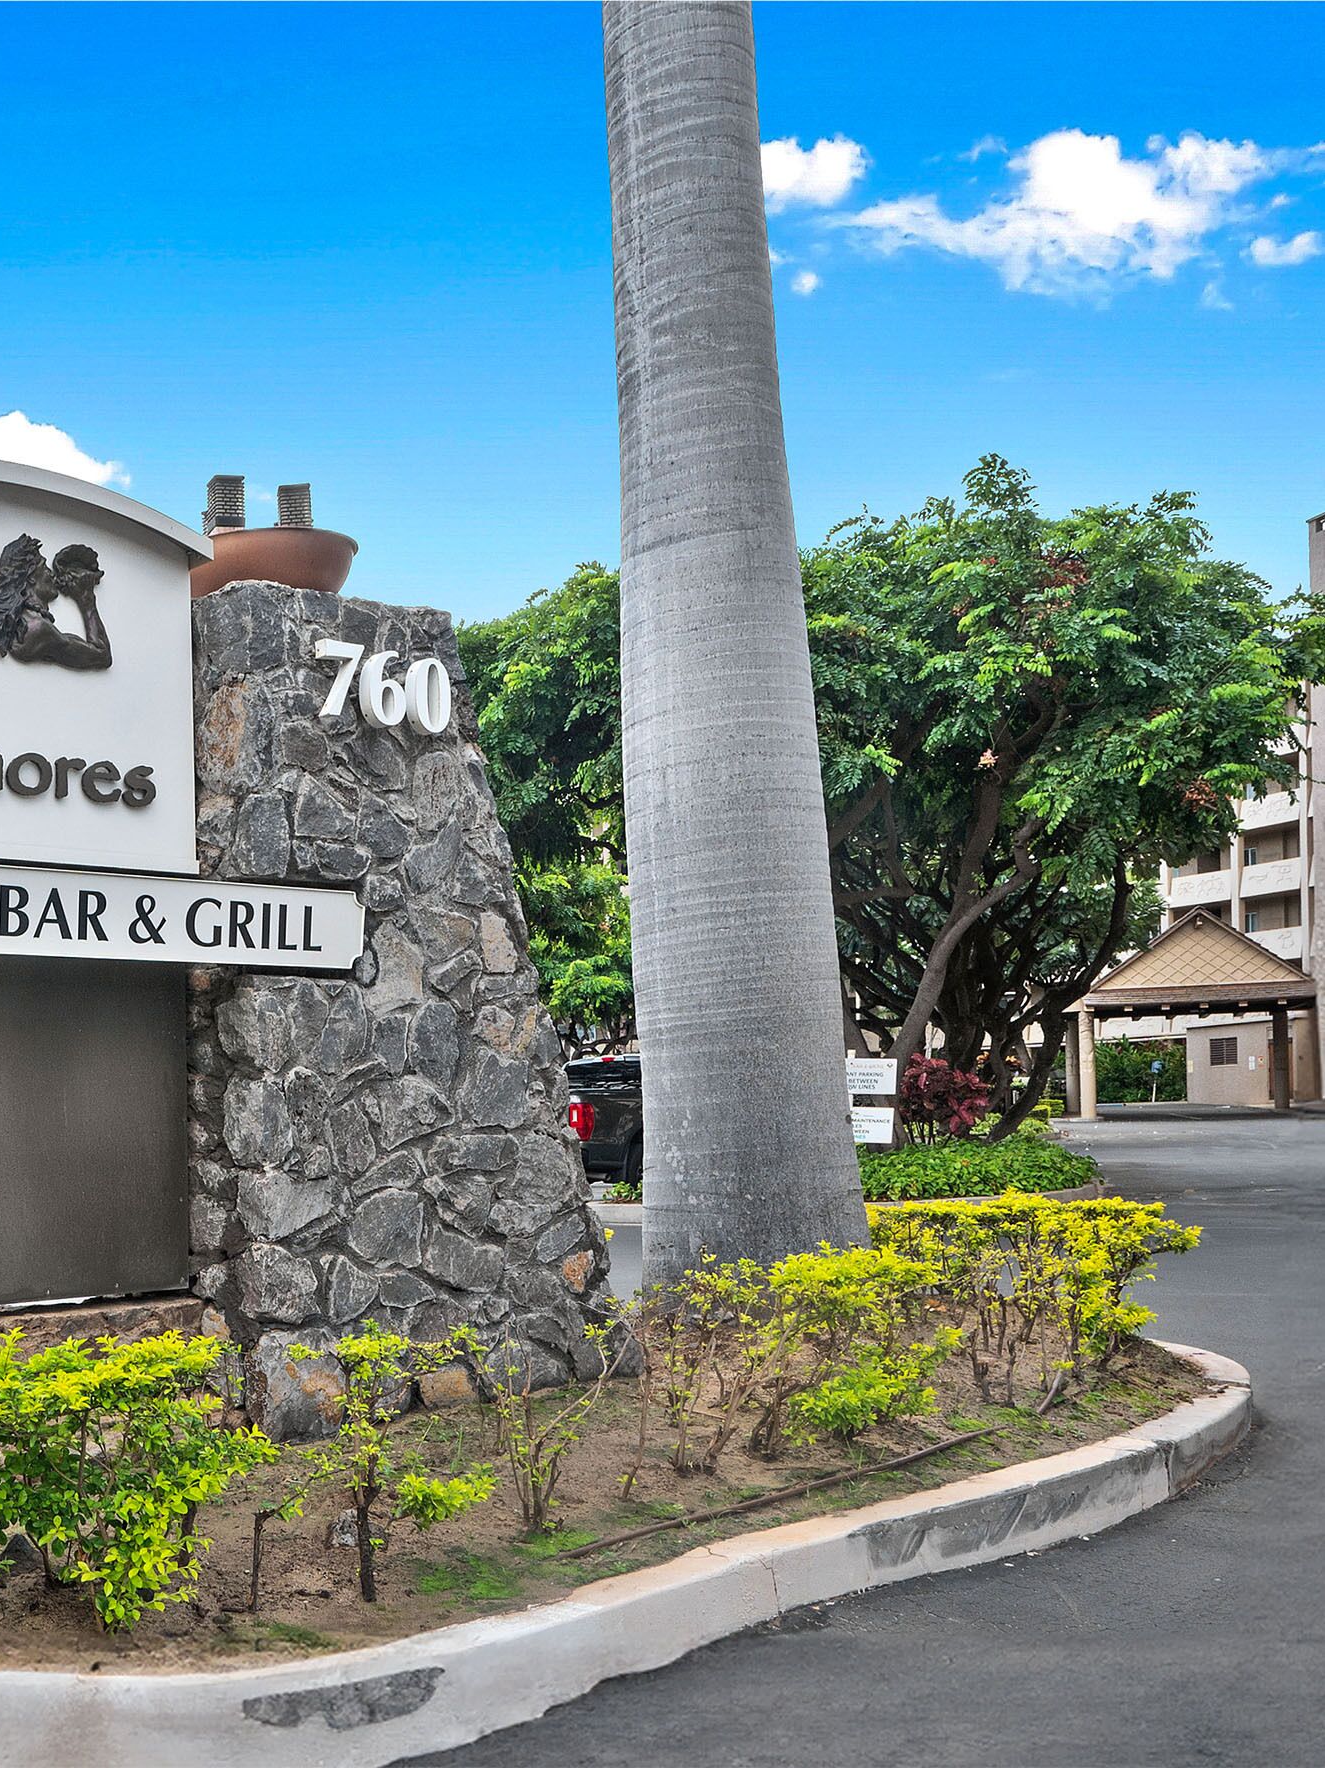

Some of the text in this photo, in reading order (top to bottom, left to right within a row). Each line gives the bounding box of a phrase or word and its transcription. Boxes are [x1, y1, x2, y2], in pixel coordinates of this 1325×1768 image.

[315, 638, 452, 735] 760
[128, 894, 167, 945] &
[185, 897, 323, 952] GRILL
